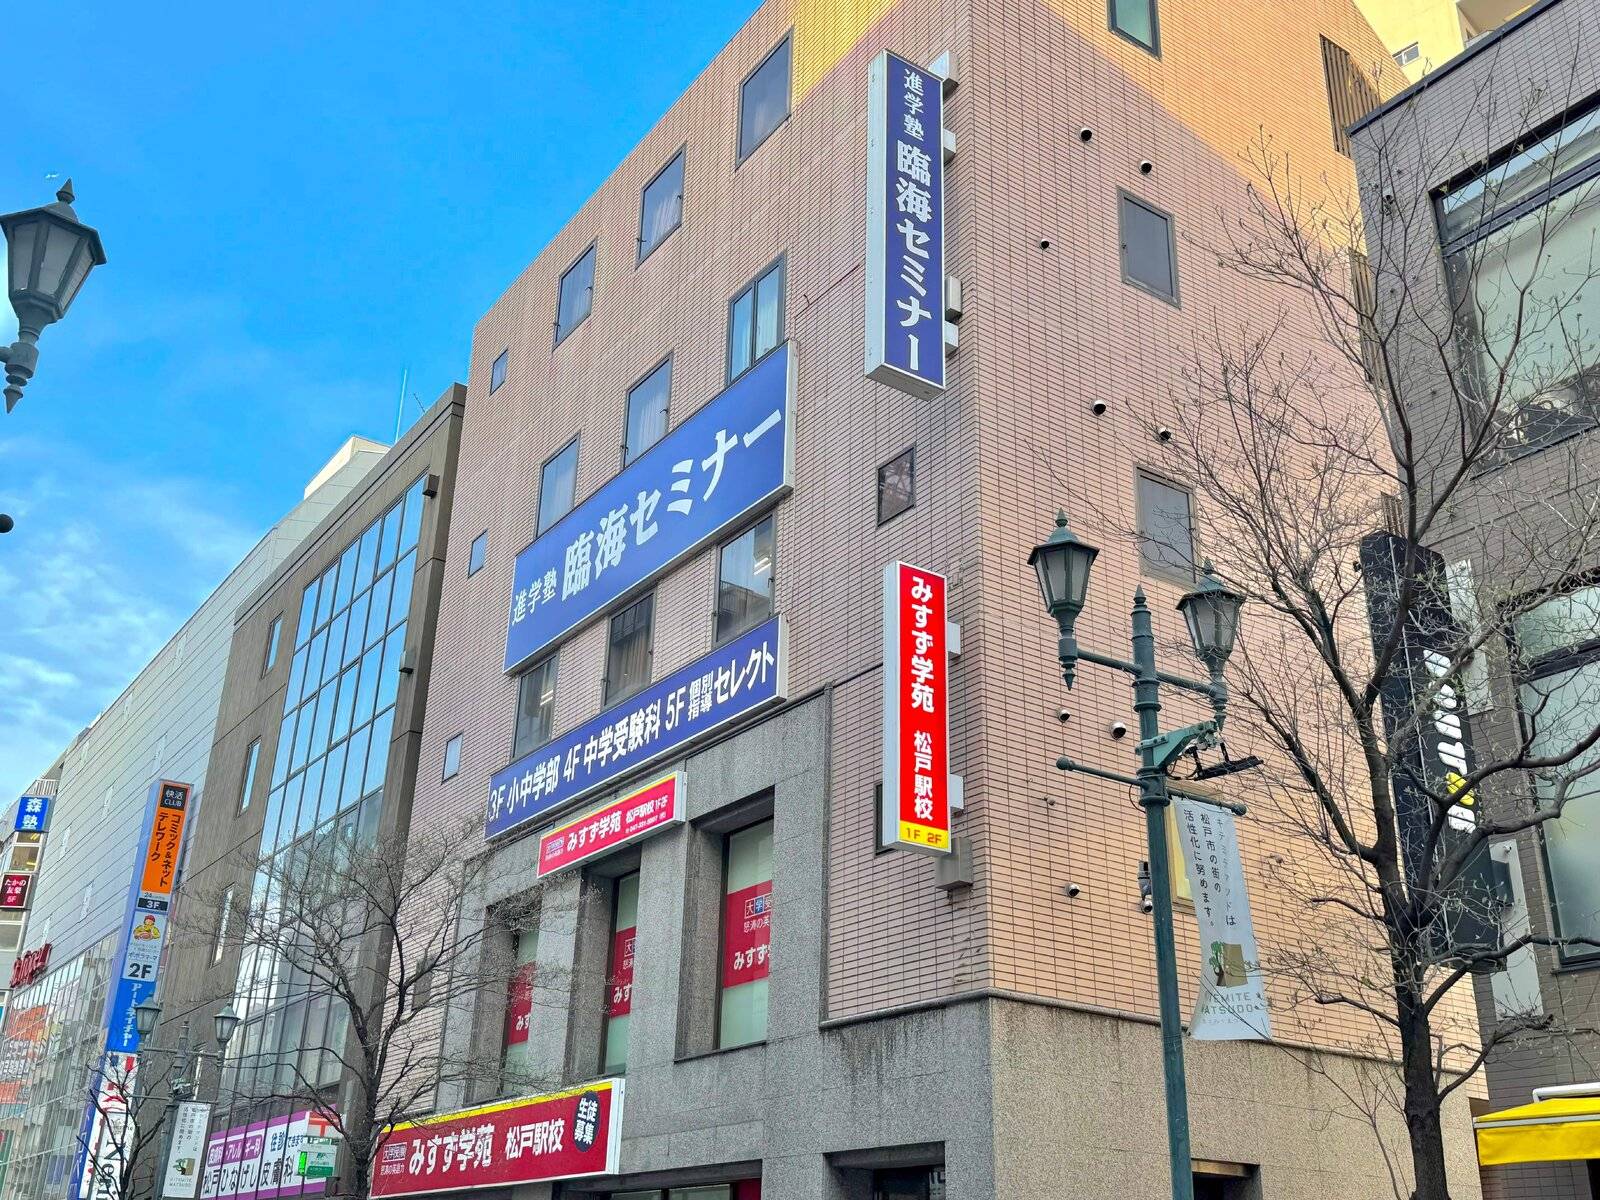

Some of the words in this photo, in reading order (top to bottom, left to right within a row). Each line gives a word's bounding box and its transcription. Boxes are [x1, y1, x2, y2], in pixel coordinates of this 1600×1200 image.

[904, 69, 924, 141] 進学塾
[896, 139, 933, 371] 臨海セミナー
[512, 567, 557, 626] 進学塾
[562, 409, 782, 602] 臨海セミナー
[911, 576, 935, 713] みすず学苑
[689, 671, 713, 701] 個別
[713, 641, 775, 703] セレクト
[688, 691, 713, 721] 指導
[489, 789, 504, 823] 3F
[506, 755, 561, 815] 小中学部
[563, 744, 581, 782] 4F
[583, 698, 661, 773] 中学受験科
[665, 686, 686, 730] 5F
[914, 731, 933, 821] 松戸駅校
[164, 799, 182, 807] CLUB
[166, 789, 184, 801] 快活
[22, 798, 42, 830] 森塾
[567, 810, 622, 852] みすず学苑
[151, 812, 169, 861] テレワーク
[906, 827, 921, 840] 1F
[927, 831, 943, 844] 2F
[1201, 813, 1221, 893] 松戸市の街の
[146, 900, 160, 910] 3F
[128, 963, 152, 978] 2F
[733, 944, 770, 970] みすず
[577, 1098, 598, 1123] 生徒
[409, 1123, 495, 1176] みすず学苑
[505, 1118, 565, 1160] 松戸駅校
[574, 1118, 597, 1145] 募集
